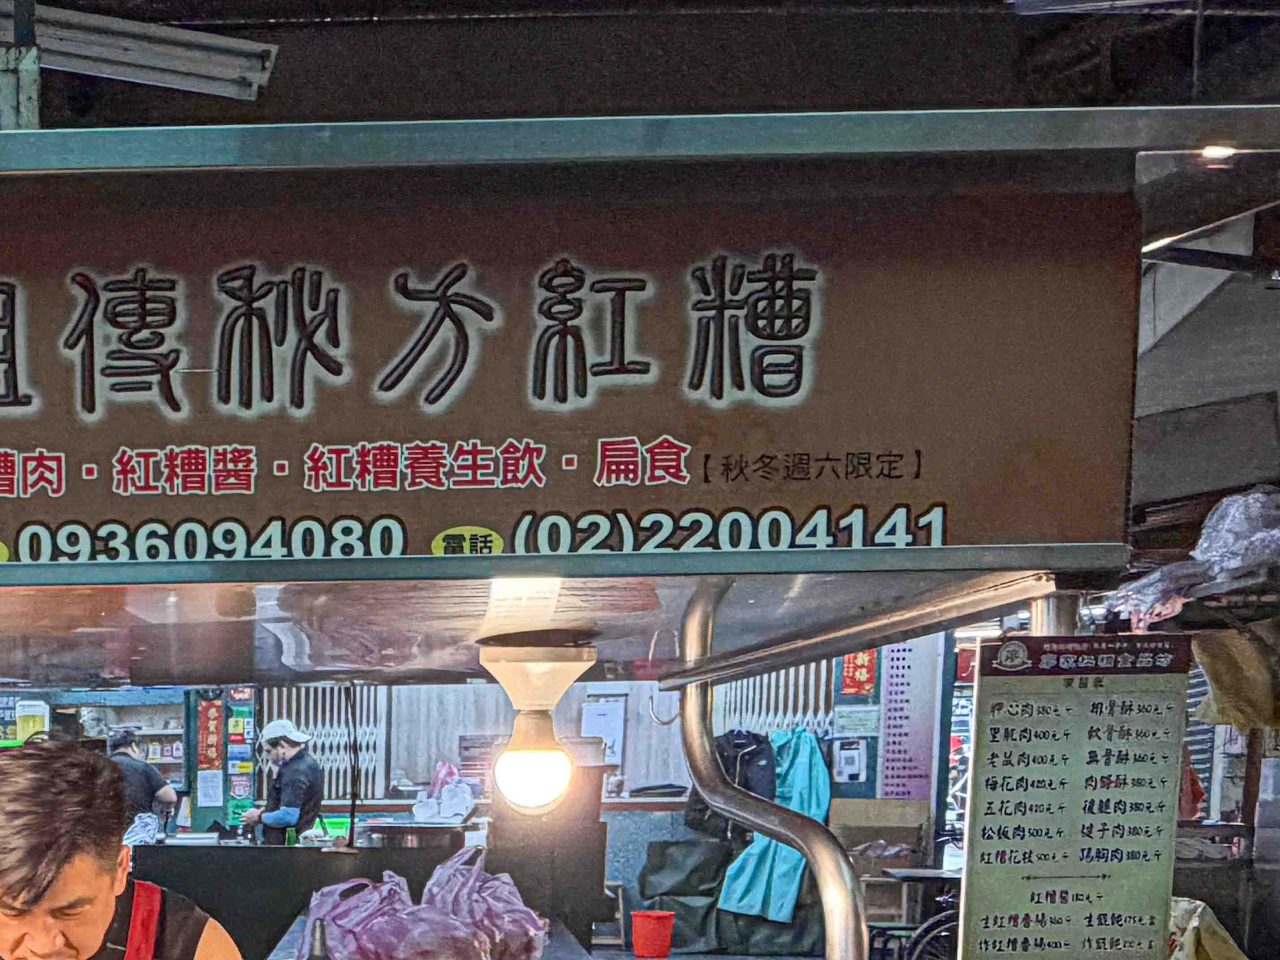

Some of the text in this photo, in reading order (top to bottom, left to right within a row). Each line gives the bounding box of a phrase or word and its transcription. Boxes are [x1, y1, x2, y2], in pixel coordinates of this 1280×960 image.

[112, 444, 257, 497] 紅糟醬
[304, 438, 547, 495] 紅糟養生飲
[593, 434, 692, 487] 扁食
[18, 517, 405, 561] 0936094080
[513, 505, 946, 554] (02)22004141
